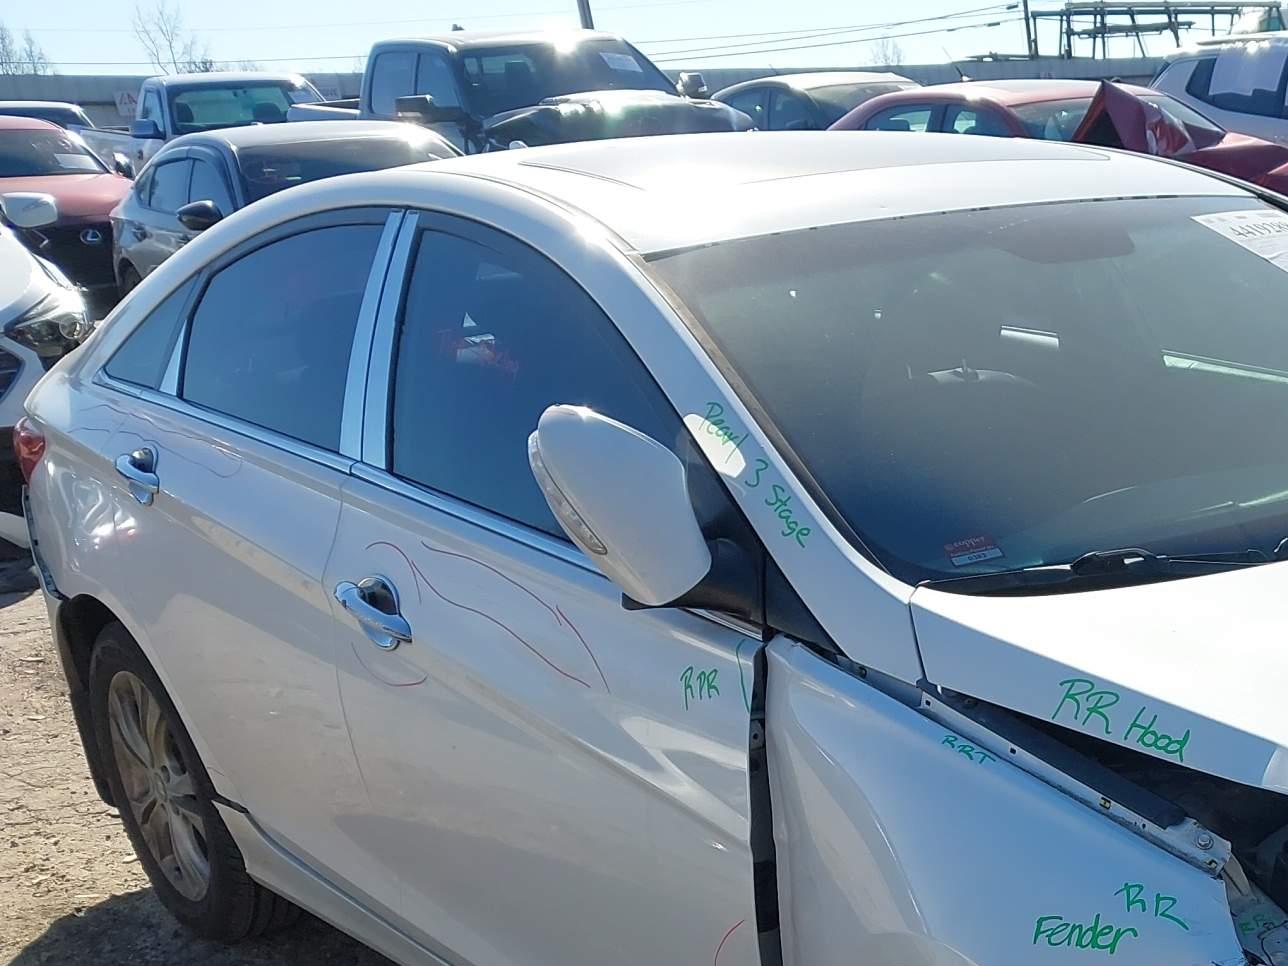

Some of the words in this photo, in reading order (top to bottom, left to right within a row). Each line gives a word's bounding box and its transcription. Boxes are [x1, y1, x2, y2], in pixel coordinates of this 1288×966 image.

[698, 401, 749, 464] Pearl
[745, 458, 769, 488] 3
[765, 484, 811, 548] Stage
[1052, 678, 1112, 734] RR
[1124, 706, 1190, 763] Hood
[1033, 913, 1138, 955] Fender
